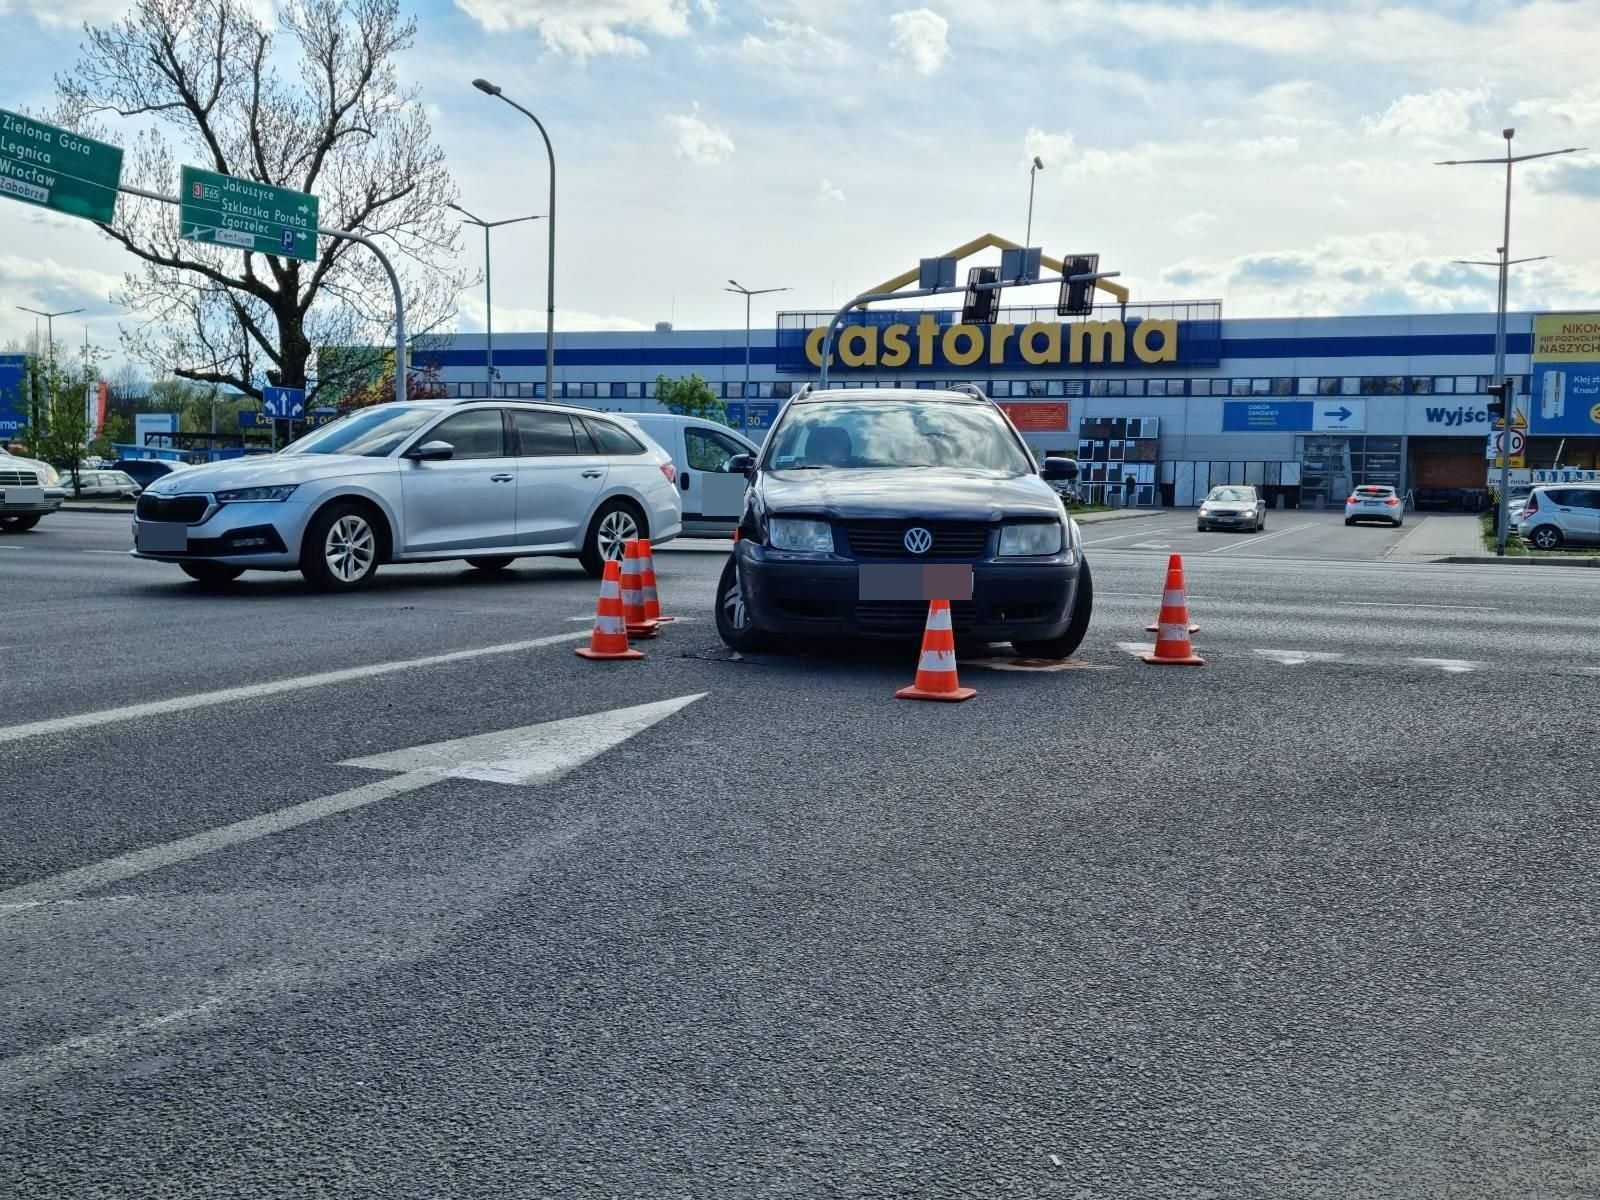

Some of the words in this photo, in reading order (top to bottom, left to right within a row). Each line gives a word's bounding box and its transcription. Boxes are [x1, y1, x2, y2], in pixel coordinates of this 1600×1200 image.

[3, 115, 52, 143] Zielona
[59, 133, 91, 155] Góra
[0, 136, 52, 164] Legnica
[0, 157, 56, 187] Wrocław
[0, 177, 46, 200] Zabobrze
[194, 184, 201, 196] 3
[204, 188, 219, 200] E65
[223, 178, 274, 201] Jakuszyce
[221, 213, 269, 233] Zgorzelec
[222, 198, 270, 219] Szklarska
[274, 209, 307, 227] Poręba
[805, 314, 1177, 367] castorama
[1540, 343, 1600, 353] NASZYCH
[1573, 386, 1599, 394] Knauf
[1574, 375, 1591, 385] Klej
[0, 420, 17, 430] ma
[747, 416, 761, 426] 30
